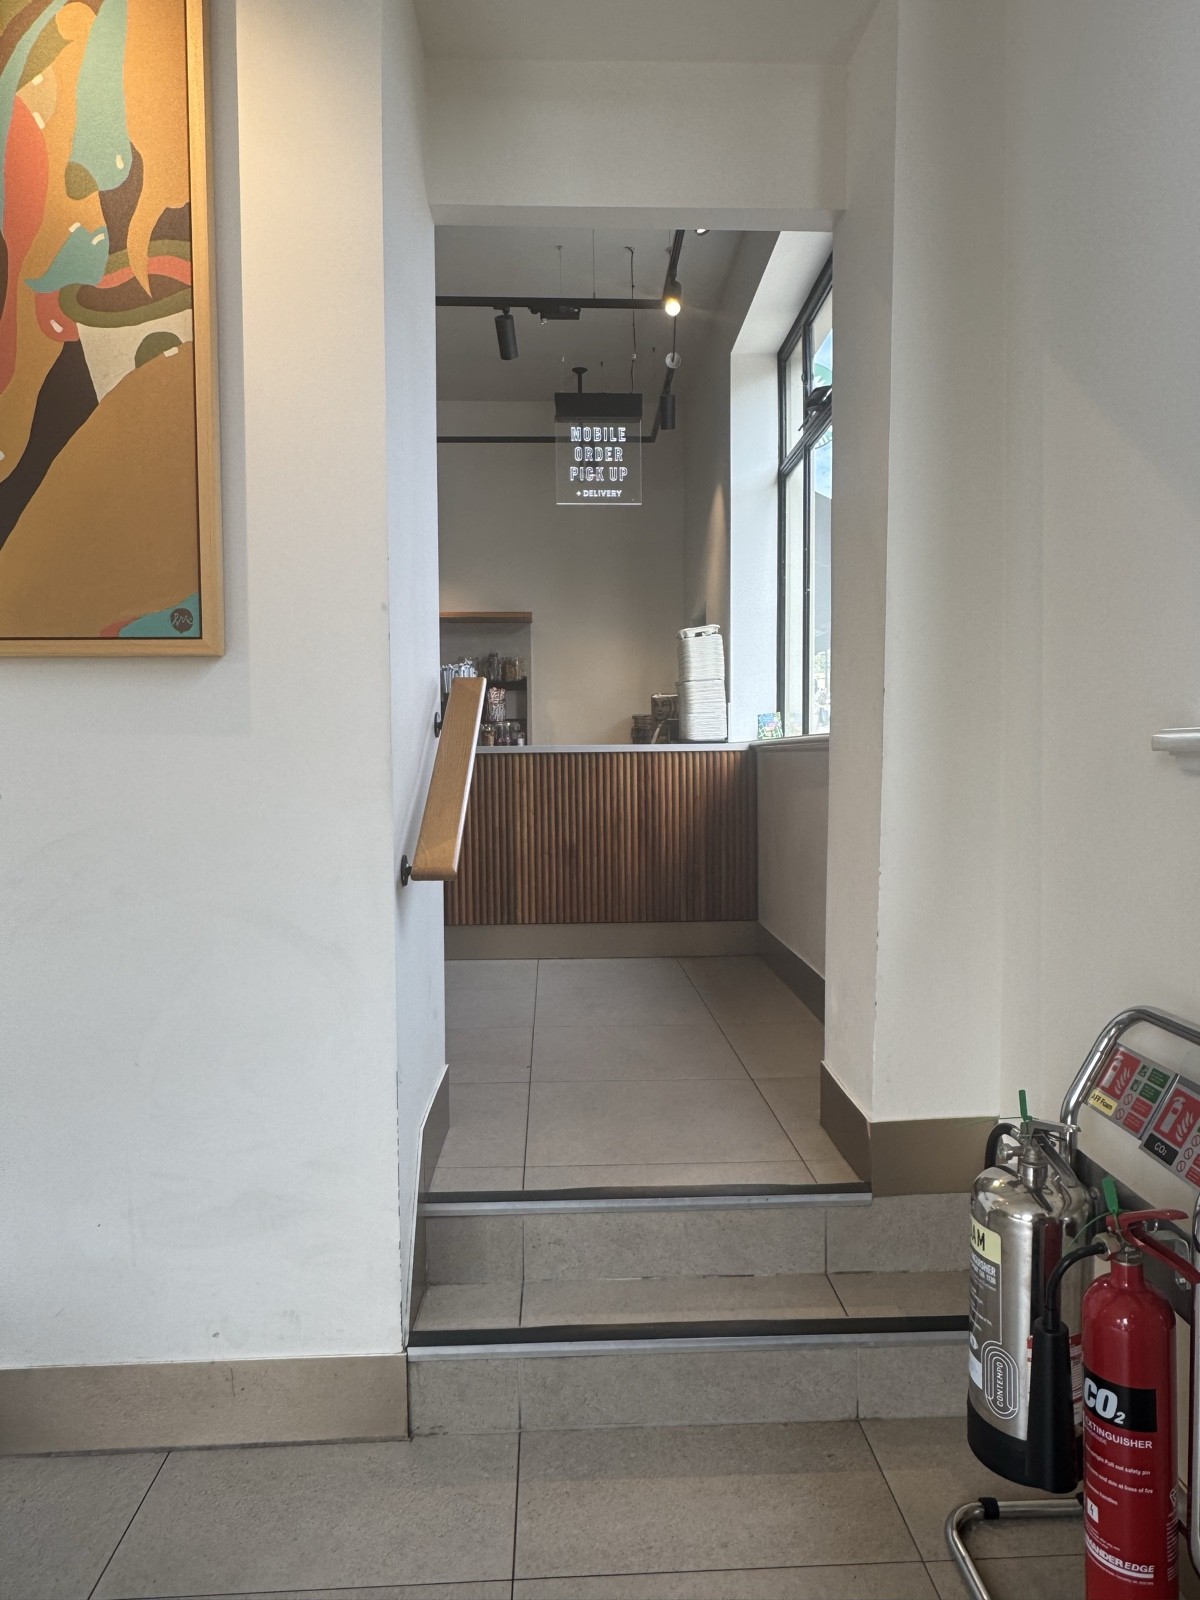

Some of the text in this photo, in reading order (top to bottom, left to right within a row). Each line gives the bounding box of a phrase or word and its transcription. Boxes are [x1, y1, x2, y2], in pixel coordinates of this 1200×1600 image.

[570, 427, 626, 442] MOBILE
[574, 446, 624, 462] ORDER
[569, 466, 628, 481] PICK UP
[996, 1362, 1004, 1408] CONTEMPO
